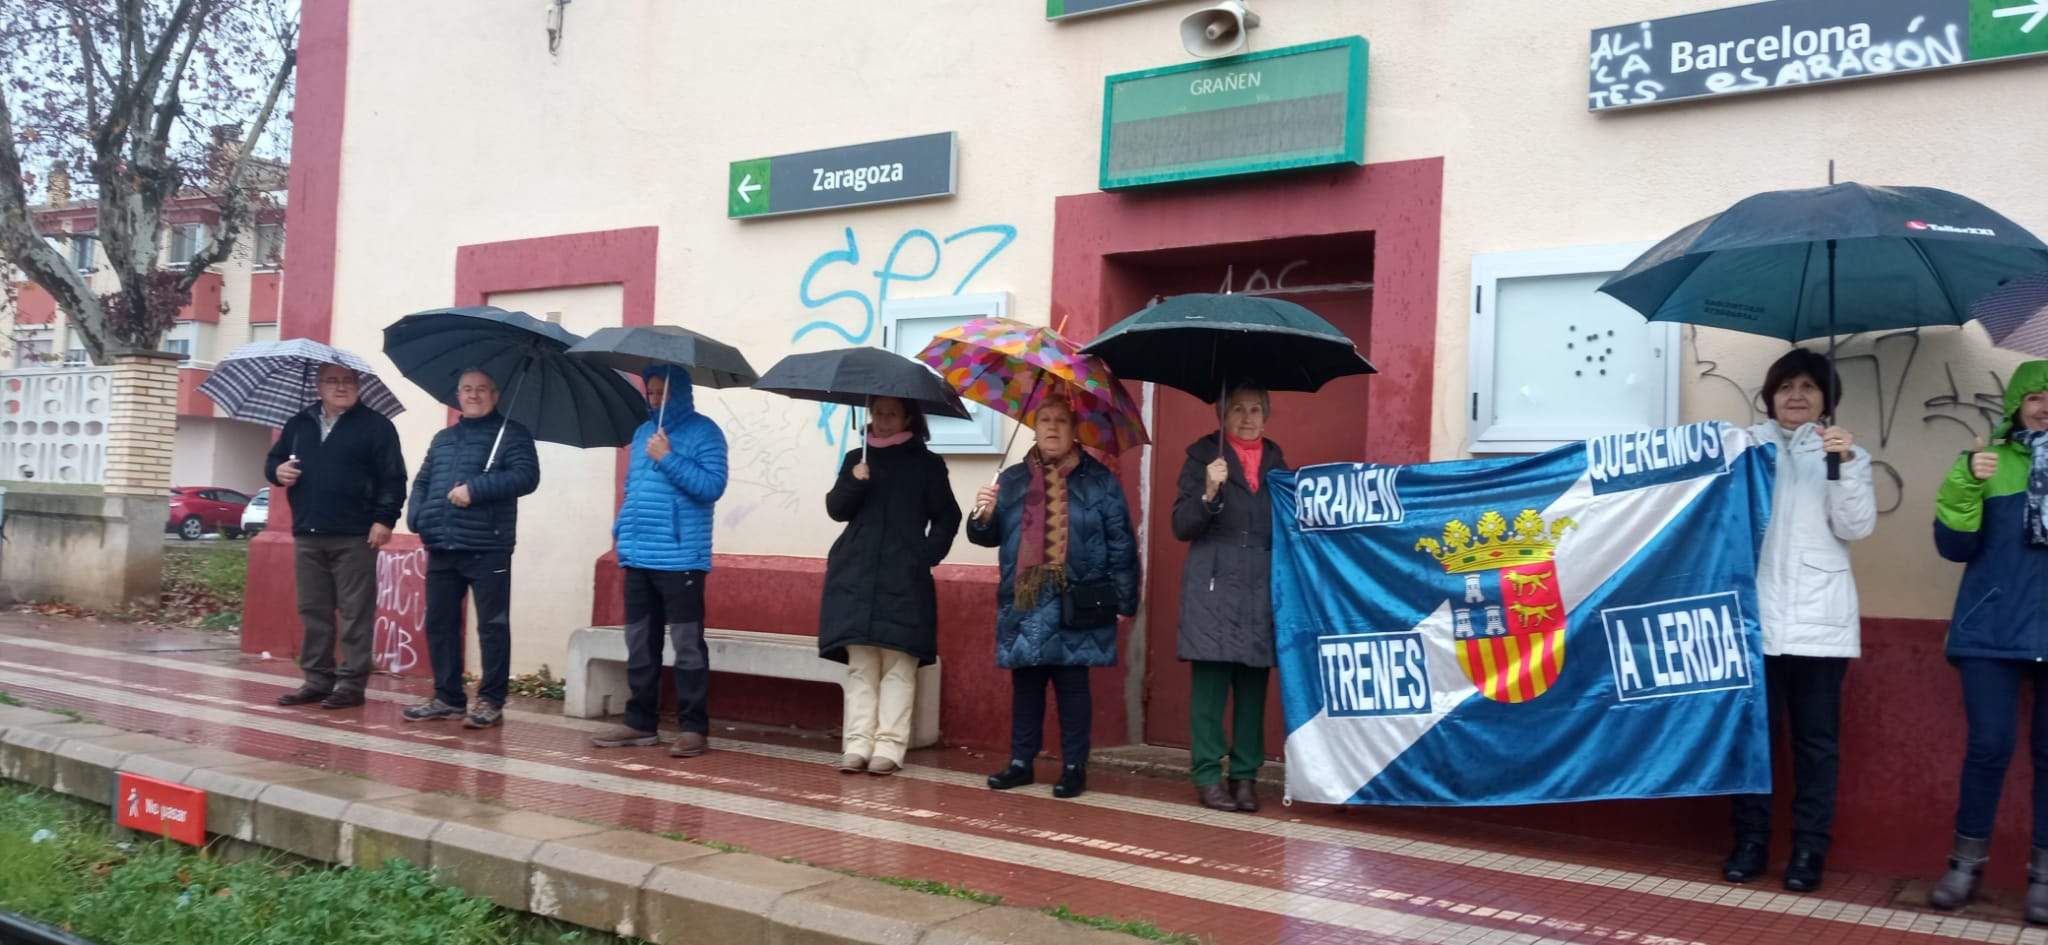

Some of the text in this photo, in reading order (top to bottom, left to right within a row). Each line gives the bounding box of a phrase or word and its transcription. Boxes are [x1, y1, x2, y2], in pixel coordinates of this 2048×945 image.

[1670, 22, 1871, 74] Barcelona
[1190, 72, 1262, 96] GRAÑEN
[812, 162, 904, 192] Zaragoza
[1590, 421, 1720, 483] QUEREMOS
[1616, 605, 1745, 691] A LERIDA
[1321, 638, 1426, 711] TRENES
[145, 798, 160, 815] No
